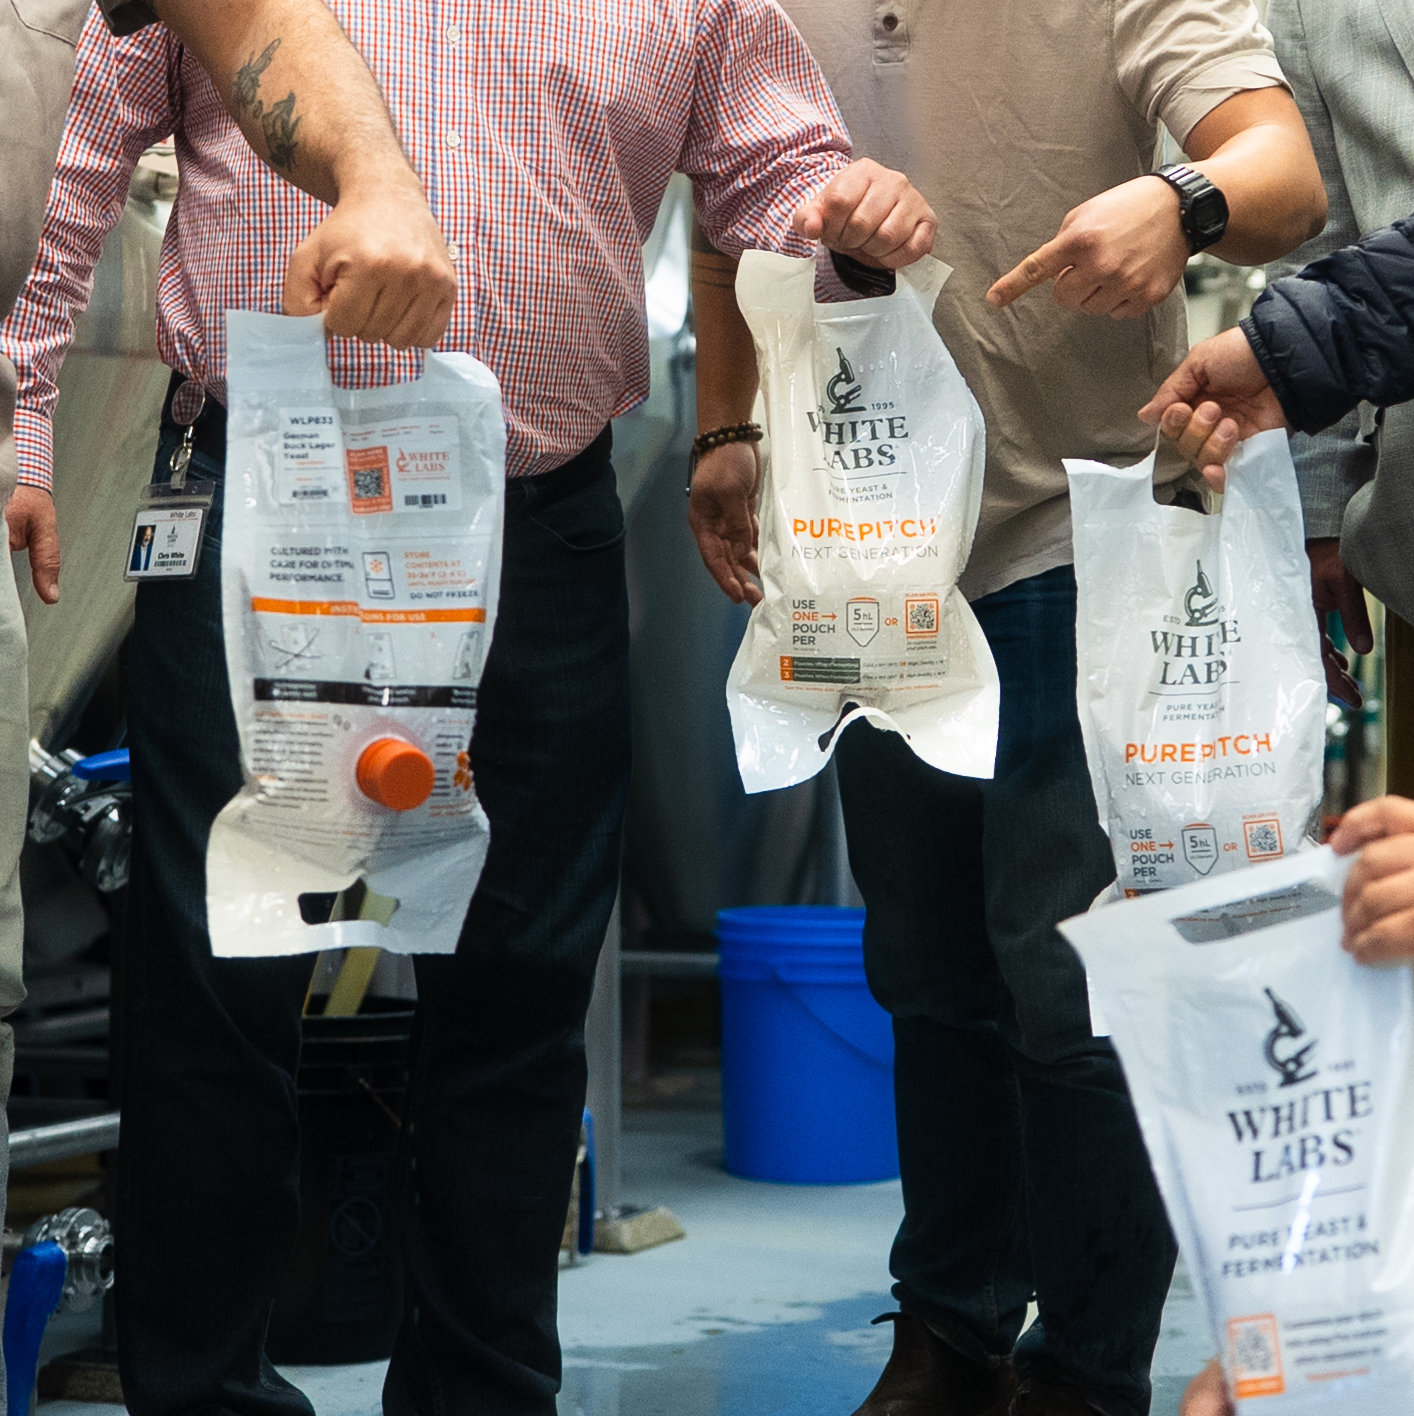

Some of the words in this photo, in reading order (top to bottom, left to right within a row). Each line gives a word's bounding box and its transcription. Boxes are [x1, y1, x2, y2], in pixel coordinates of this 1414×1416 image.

[871, 401, 894, 411] 1995
[408, 451, 450, 461] WHITE
[823, 443, 896, 470] ABS
[415, 462, 446, 472] LABS
[793, 518, 937, 542] PUREPITCH
[791, 545, 833, 560] NEXT
[838, 545, 939, 561] GENERATION
[792, 599, 816, 610] USE
[792, 611, 819, 622] ONE
[853, 608, 862, 621] 5
[884, 617, 899, 627] OR
[792, 623, 836, 634] POUCH
[792, 635, 816, 646] PER
[1159, 659, 1228, 686] LAB
[1166, 703, 1193, 712] PURE
[1125, 733, 1273, 763] PUREPITCH
[1125, 771, 1166, 785] NEXT
[1171, 762, 1277, 785] GENERATION
[1130, 828, 1153, 840] USE
[1130, 841, 1157, 853] ONE
[1189, 835, 1198, 848] 5
[1223, 842, 1238, 852] OR
[1132, 853, 1175, 865] POUCH
[1133, 867, 1158, 878] PER
[1228, 1081, 1373, 1142] WHITE
[1252, 1130, 1355, 1183] LABS
[1228, 1230, 1280, 1251] PURE
